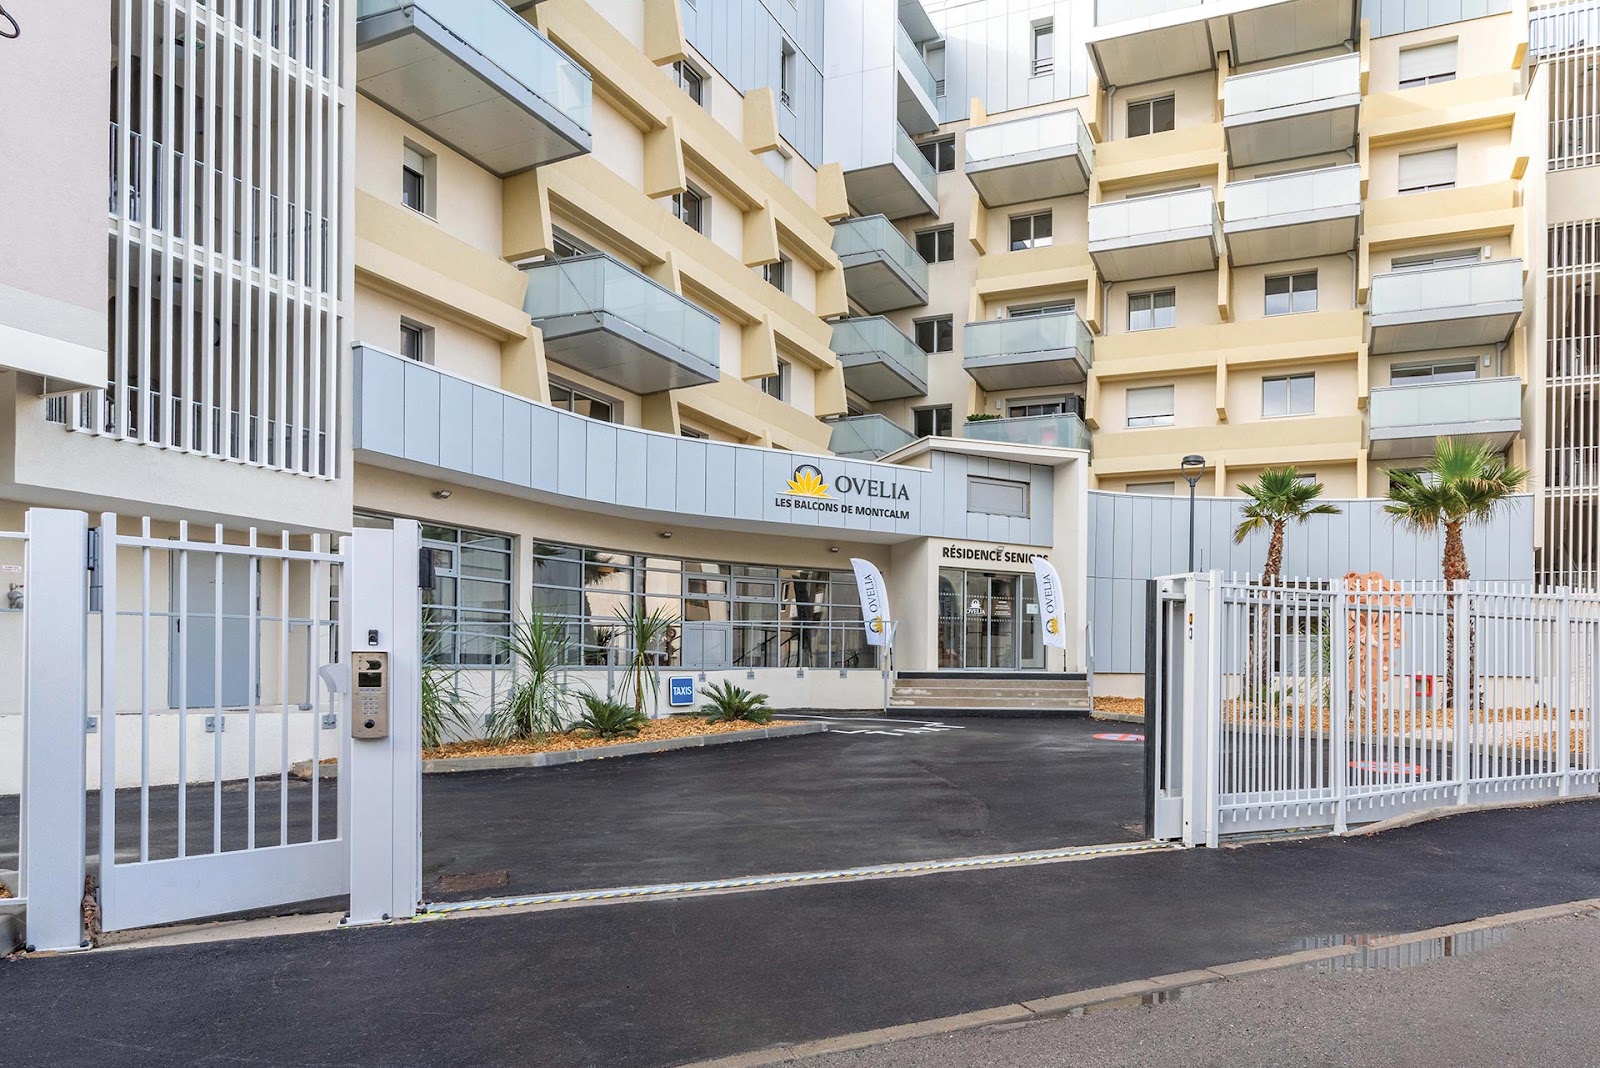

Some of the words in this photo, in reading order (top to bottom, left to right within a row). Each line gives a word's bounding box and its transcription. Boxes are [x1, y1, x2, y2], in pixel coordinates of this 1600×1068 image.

[834, 475, 910, 501] OVELIA
[775, 498, 792, 508] LES
[794, 500, 839, 512] BALCONS
[841, 504, 853, 514] DE
[855, 506, 910, 520] MONTCALM
[942, 545, 1003, 562] RÉSIDENCE
[1004, 551, 1049, 565] SENIO
[864, 573, 879, 613] OVELIA
[1042, 573, 1055, 614] OVELIA
[673, 686, 693, 696] TAXIS
